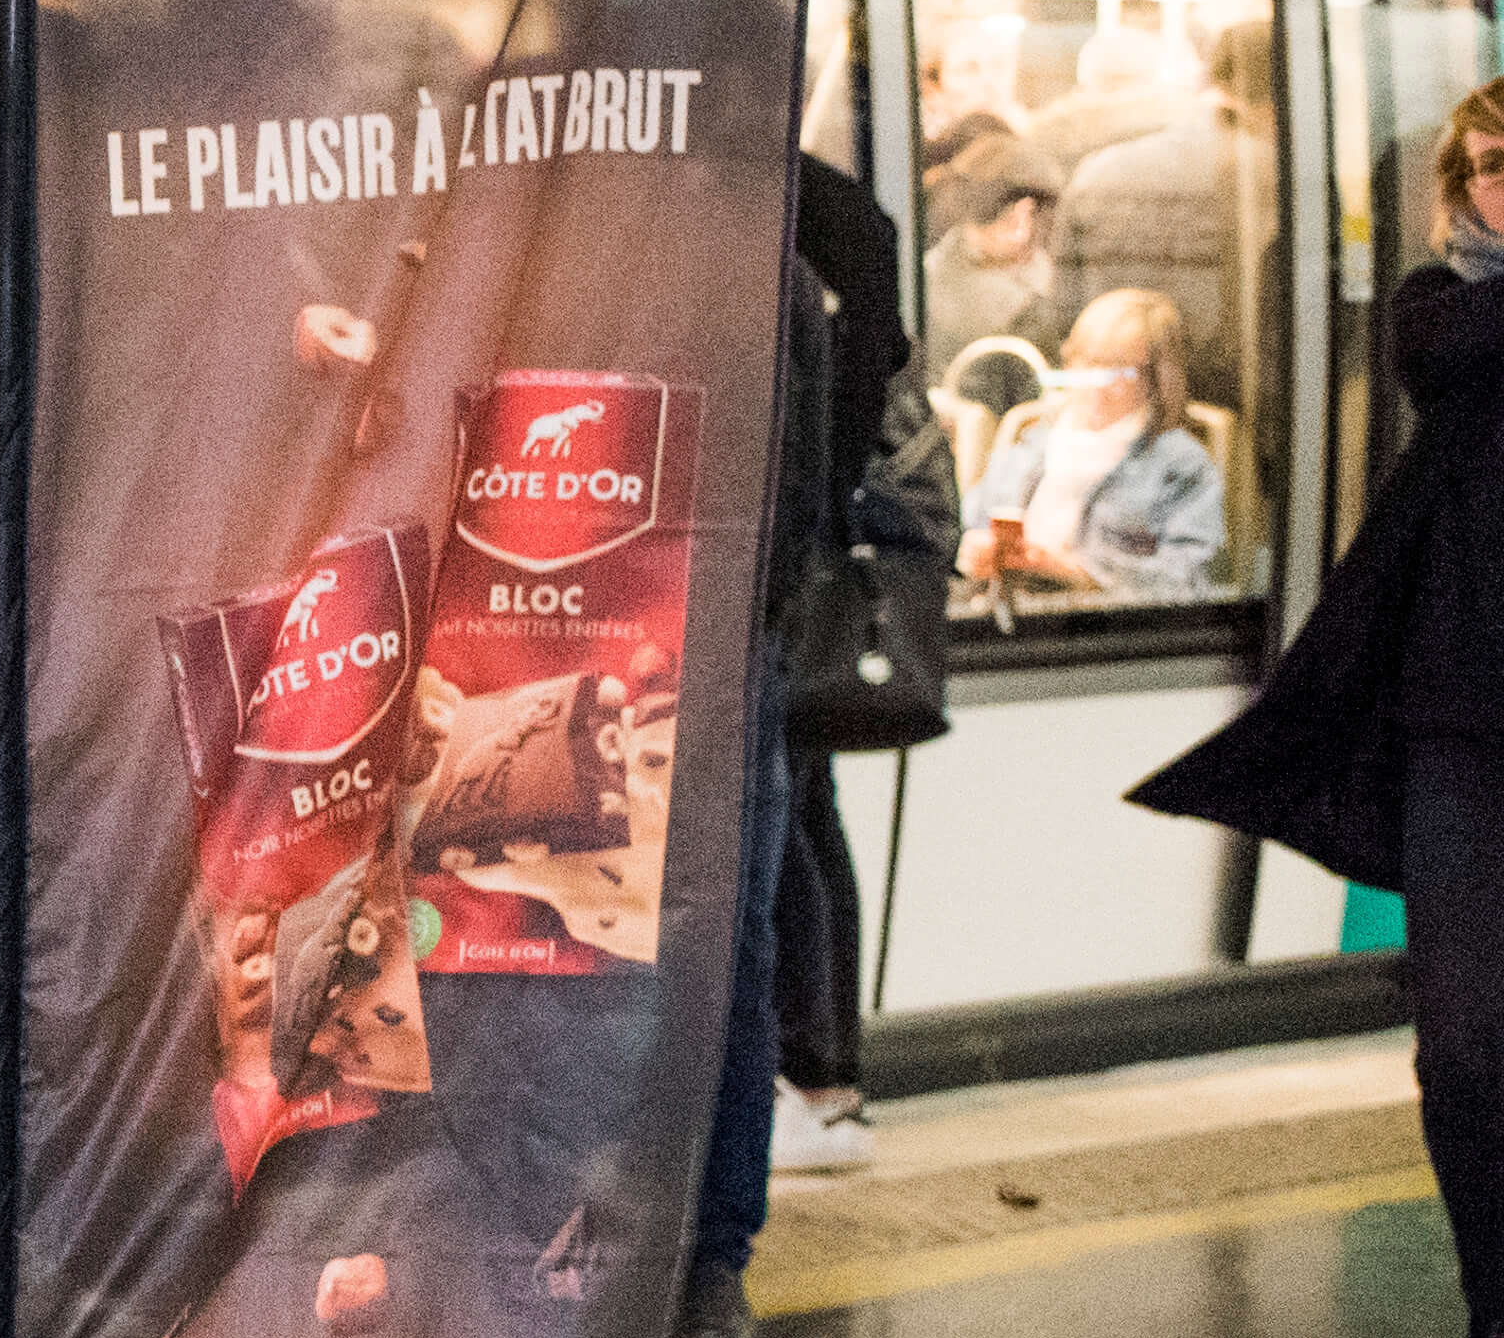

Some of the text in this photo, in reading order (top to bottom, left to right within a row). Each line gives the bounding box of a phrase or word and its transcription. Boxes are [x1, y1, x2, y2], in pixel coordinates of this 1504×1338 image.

[107, 129, 171, 216] LE
[186, 113, 397, 212] PLAISIR
[412, 86, 446, 195] À
[563, 67, 702, 156] BRUT
[467, 463, 642, 503] CÔTE D'OR
[489, 584, 584, 616] BLOC
[317, 630, 400, 681] D'OR
[291, 759, 373, 818] BLOC
